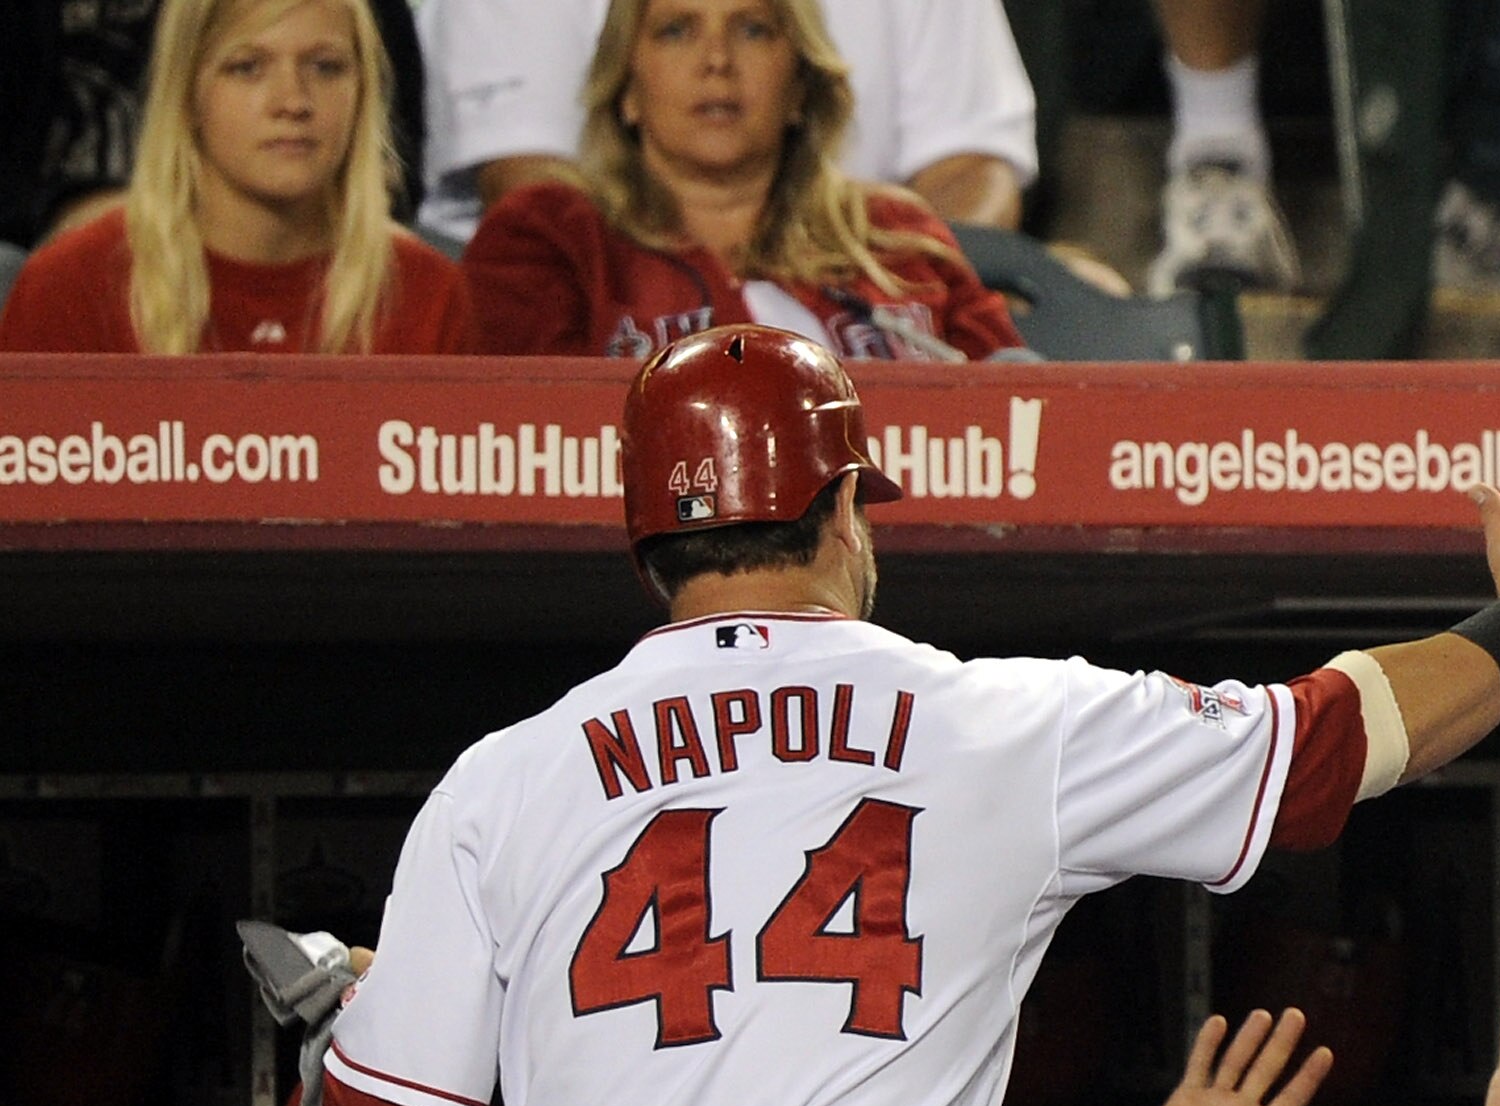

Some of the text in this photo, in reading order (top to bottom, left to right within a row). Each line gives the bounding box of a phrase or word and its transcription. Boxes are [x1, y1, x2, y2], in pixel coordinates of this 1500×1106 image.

[668, 457, 719, 496] 44
[581, 683, 915, 801] NAPOLI
[569, 797, 925, 1050] 44
